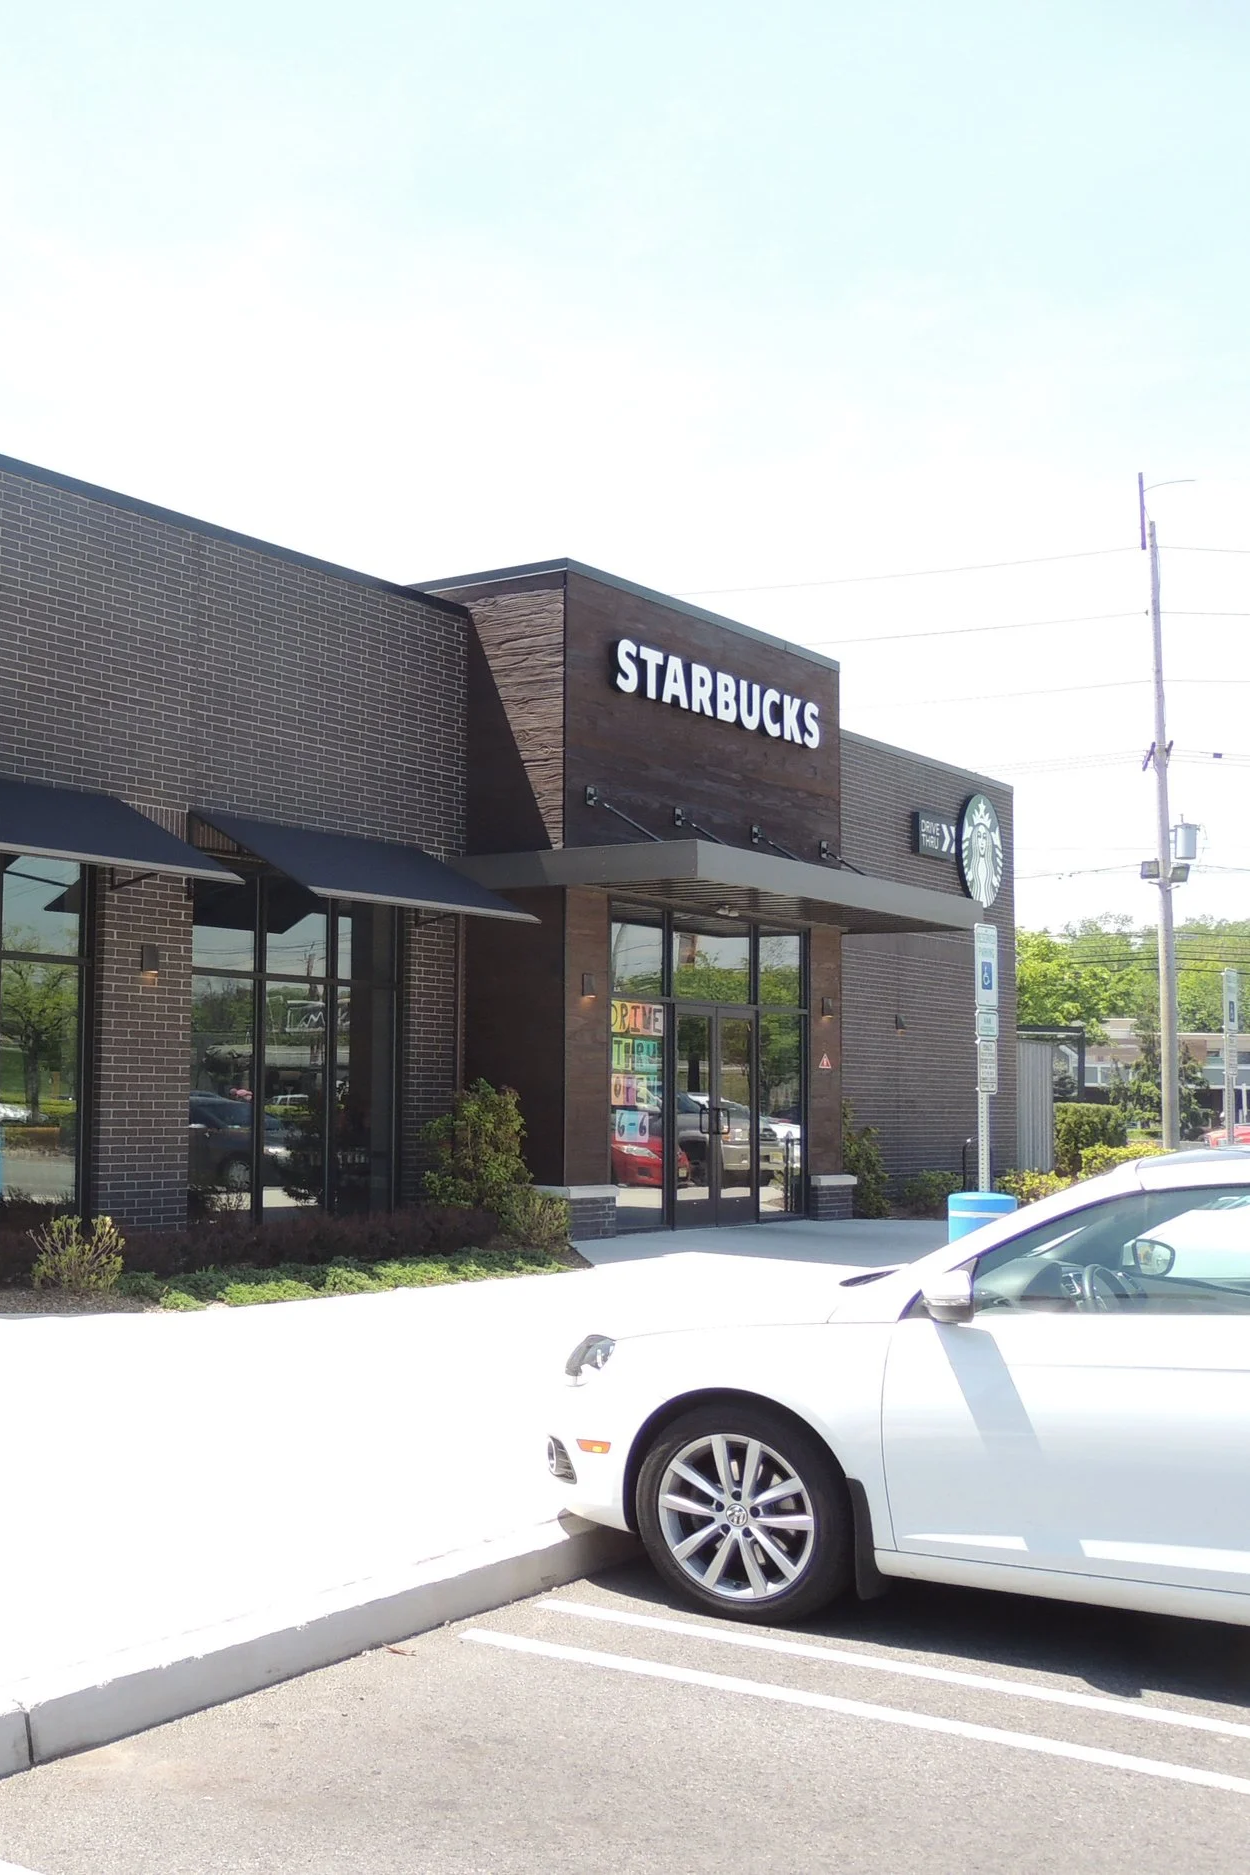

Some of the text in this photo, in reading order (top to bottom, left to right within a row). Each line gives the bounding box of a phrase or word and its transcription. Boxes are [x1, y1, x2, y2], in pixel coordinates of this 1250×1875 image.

[616, 638, 821, 749] STARBUCKS
[921, 819, 940, 836] DRIVE
[921, 833, 939, 850] THRU
[611, 1003, 662, 1033] DRIVE
